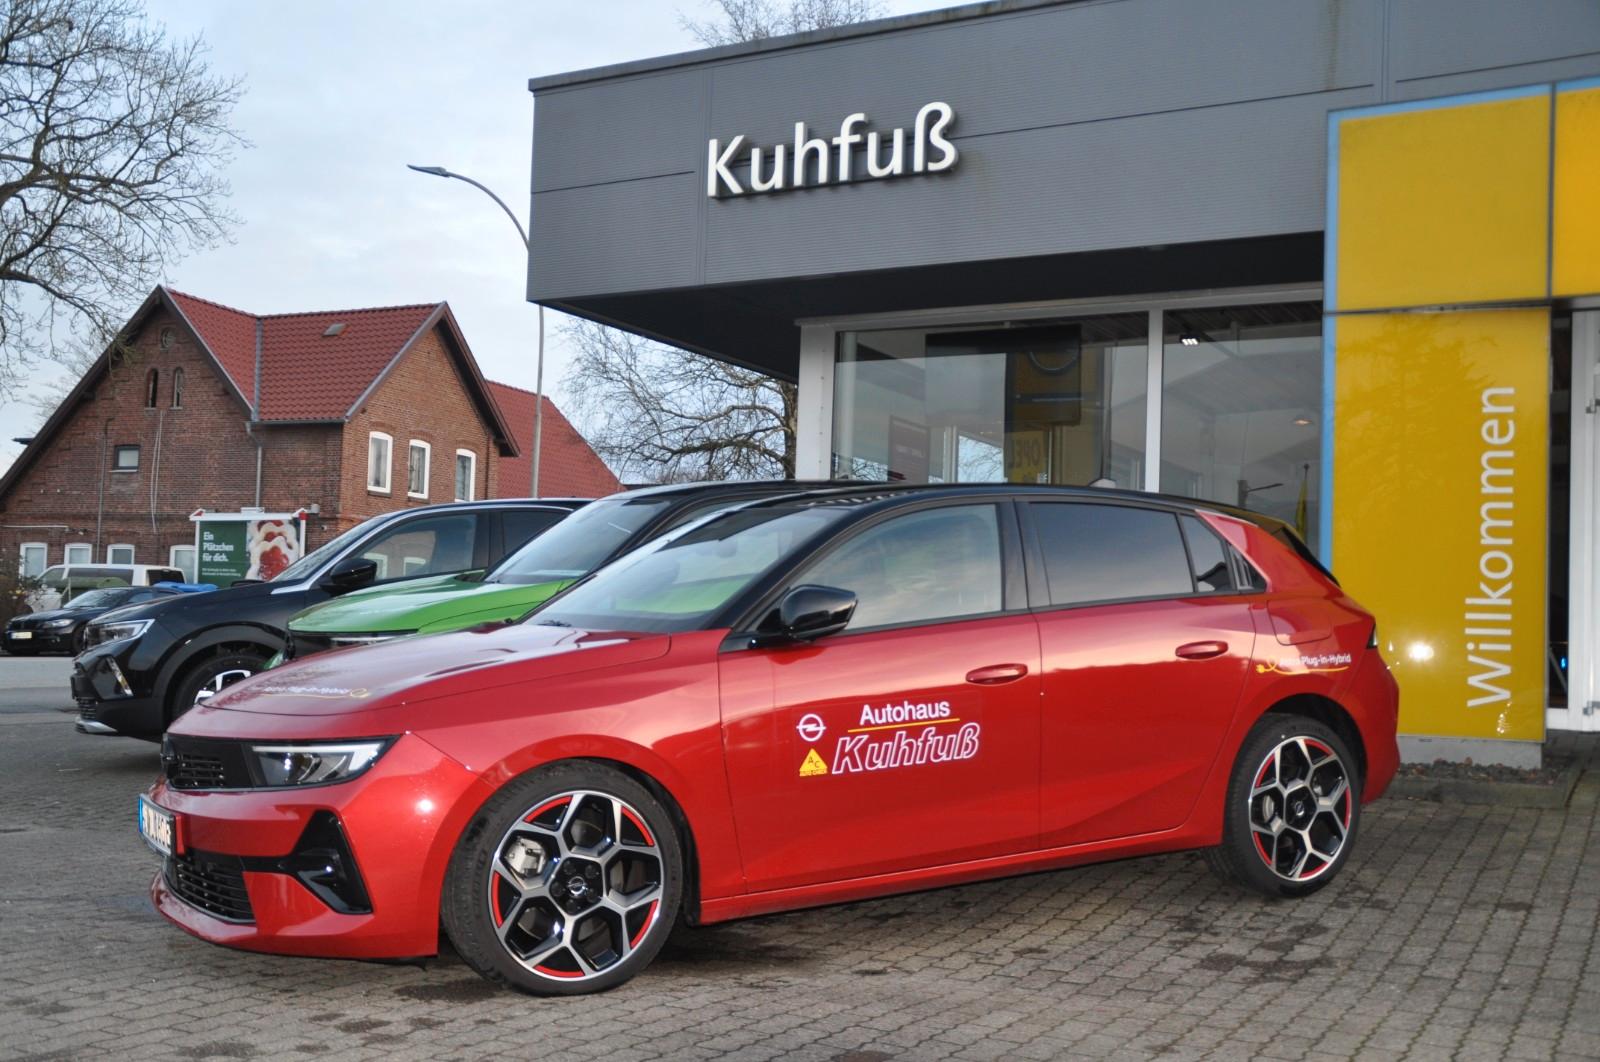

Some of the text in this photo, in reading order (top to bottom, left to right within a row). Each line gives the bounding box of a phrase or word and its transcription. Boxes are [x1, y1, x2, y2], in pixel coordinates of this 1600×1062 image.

[707, 102, 958, 197] Kuhfuß
[203, 531, 214, 540] Ein
[1464, 386, 1516, 707] Willkommen
[202, 552, 211, 561] für
[859, 701, 950, 725] Autohaus
[831, 722, 981, 774] Kuhfuß
